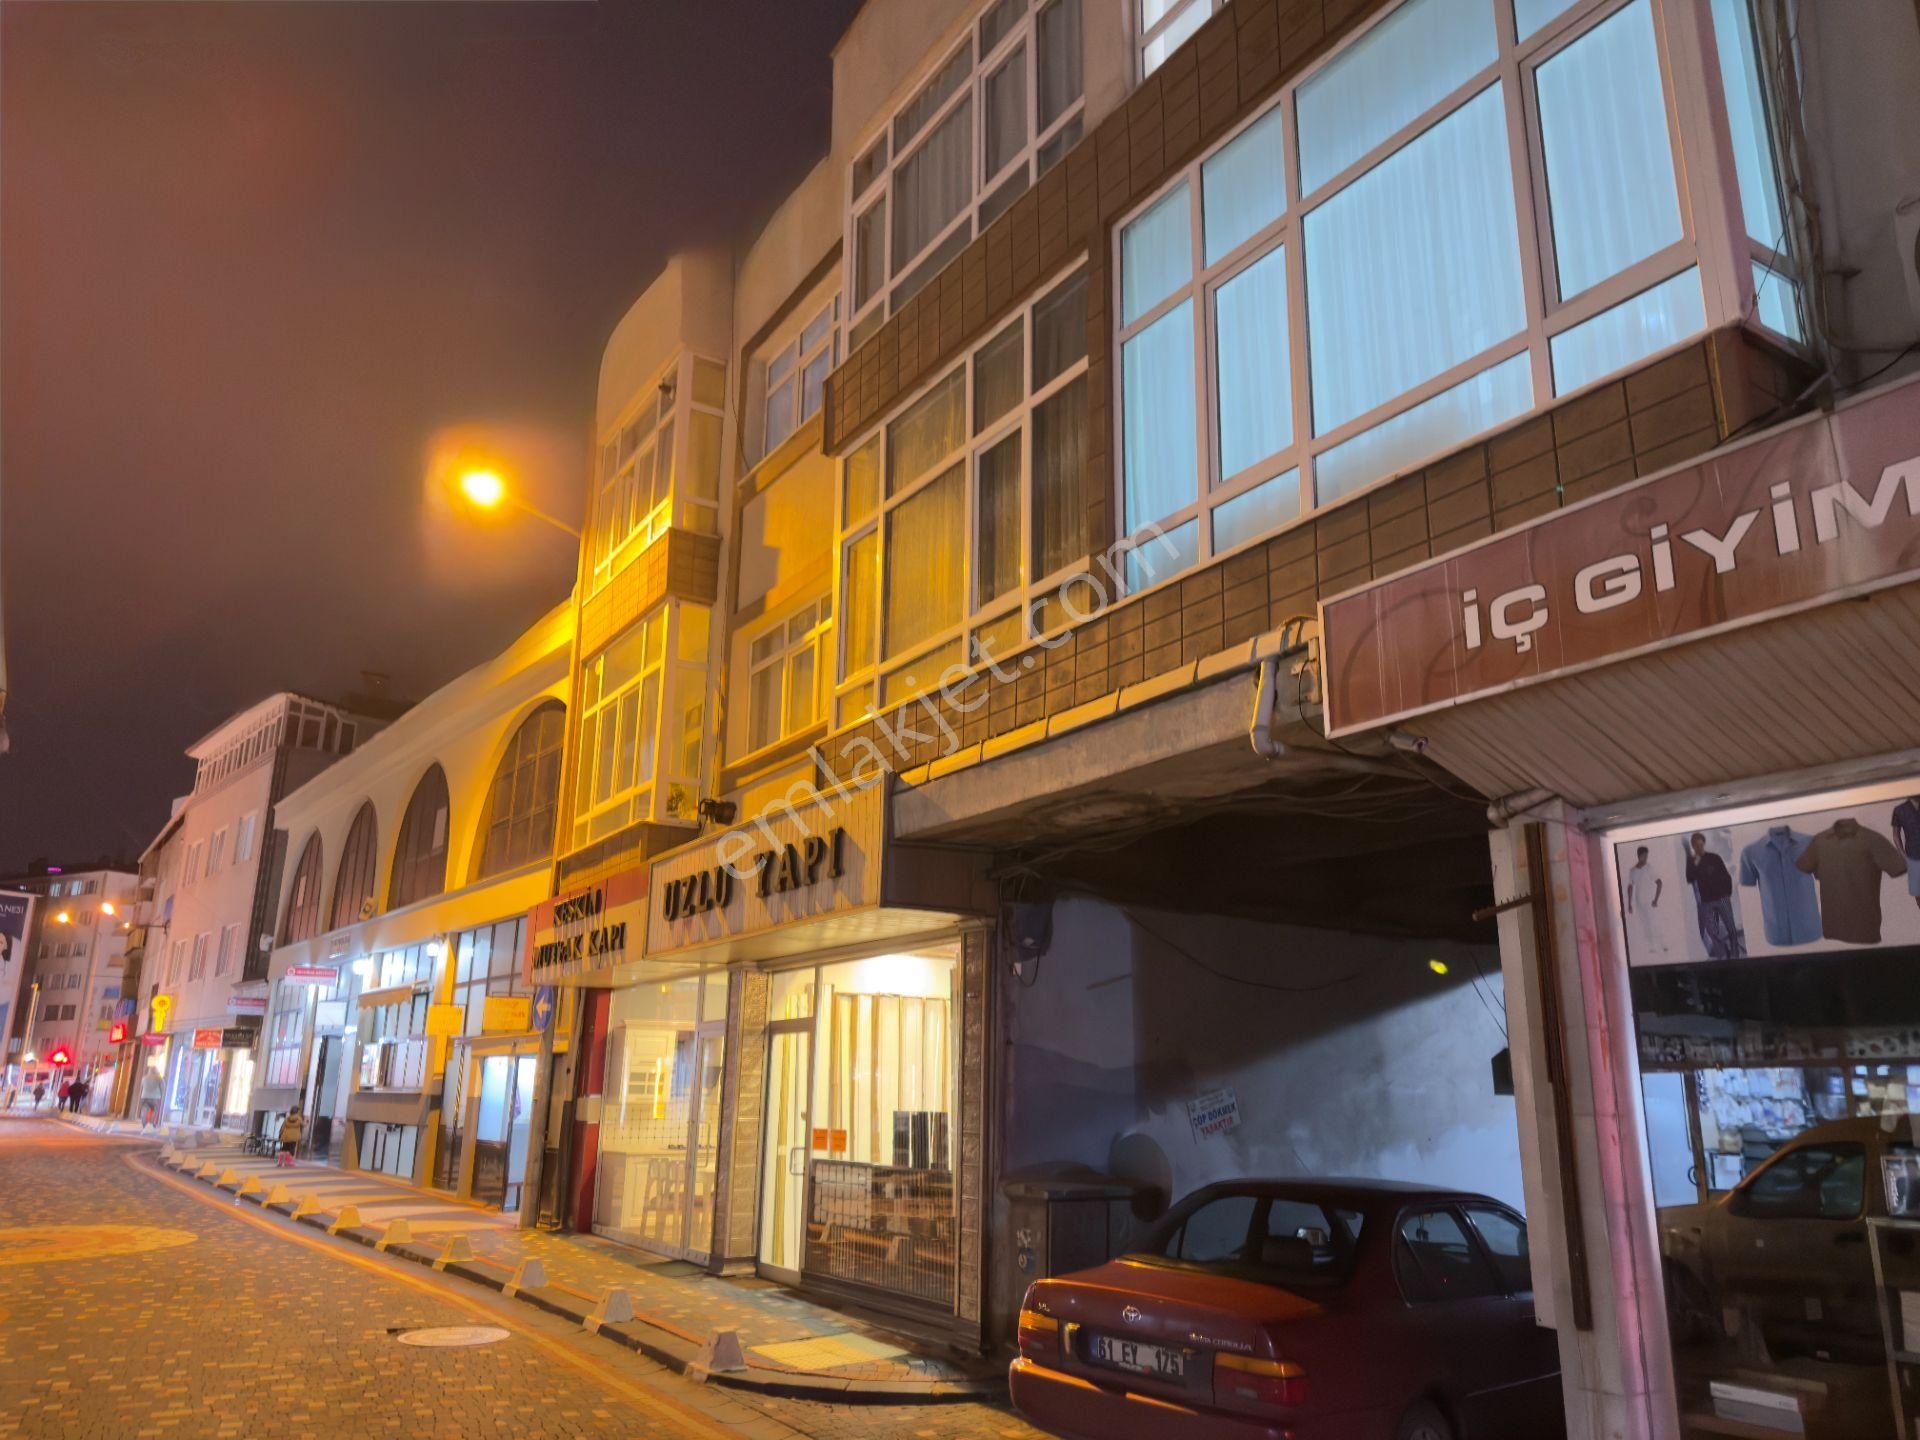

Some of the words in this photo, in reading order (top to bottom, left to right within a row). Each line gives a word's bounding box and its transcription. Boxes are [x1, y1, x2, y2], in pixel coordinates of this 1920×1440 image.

[662, 862, 736, 922] UZLU
[753, 826, 846, 899] YAPI
[588, 922, 627, 957] KAPI
